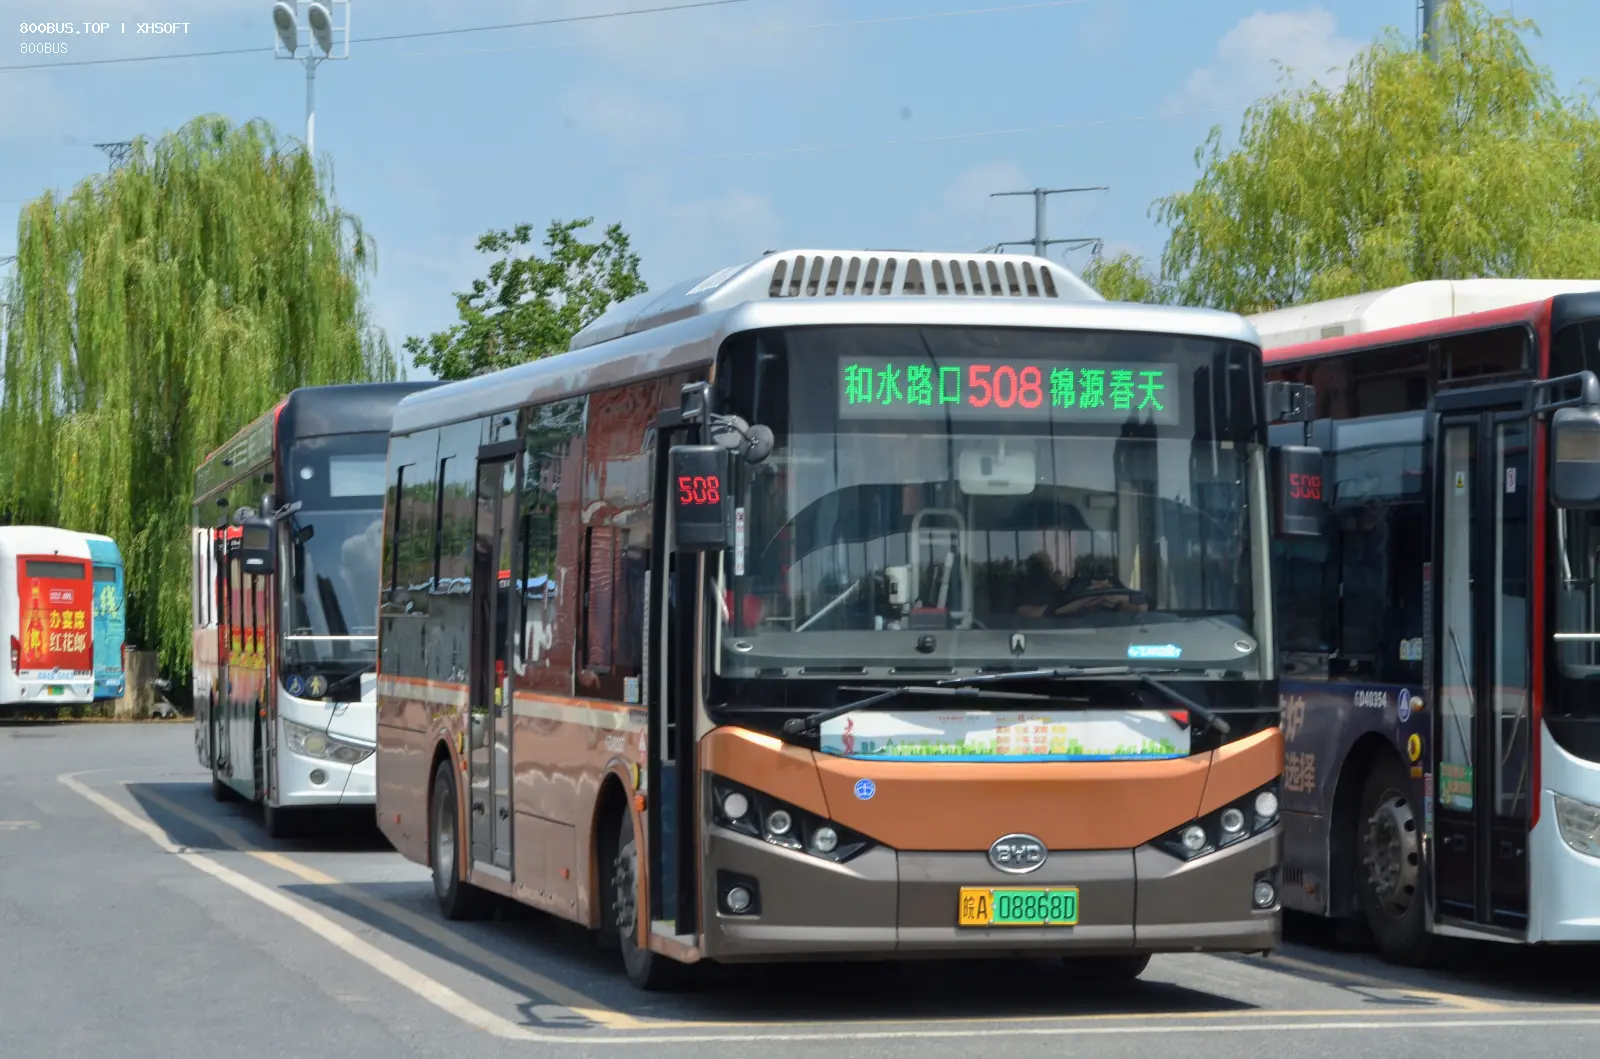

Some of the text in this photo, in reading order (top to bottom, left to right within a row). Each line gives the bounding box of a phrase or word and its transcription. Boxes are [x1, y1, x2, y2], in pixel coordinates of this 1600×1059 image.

[844, 363, 1165, 411] 和水路口 508 锦源春天
[678, 475, 720, 505] 508
[1289, 473, 1321, 500] 508
[49, 632, 87, 653] 红花郎
[996, 844, 1041, 862] BYD
[999, 895, 1075, 919] 08868D
